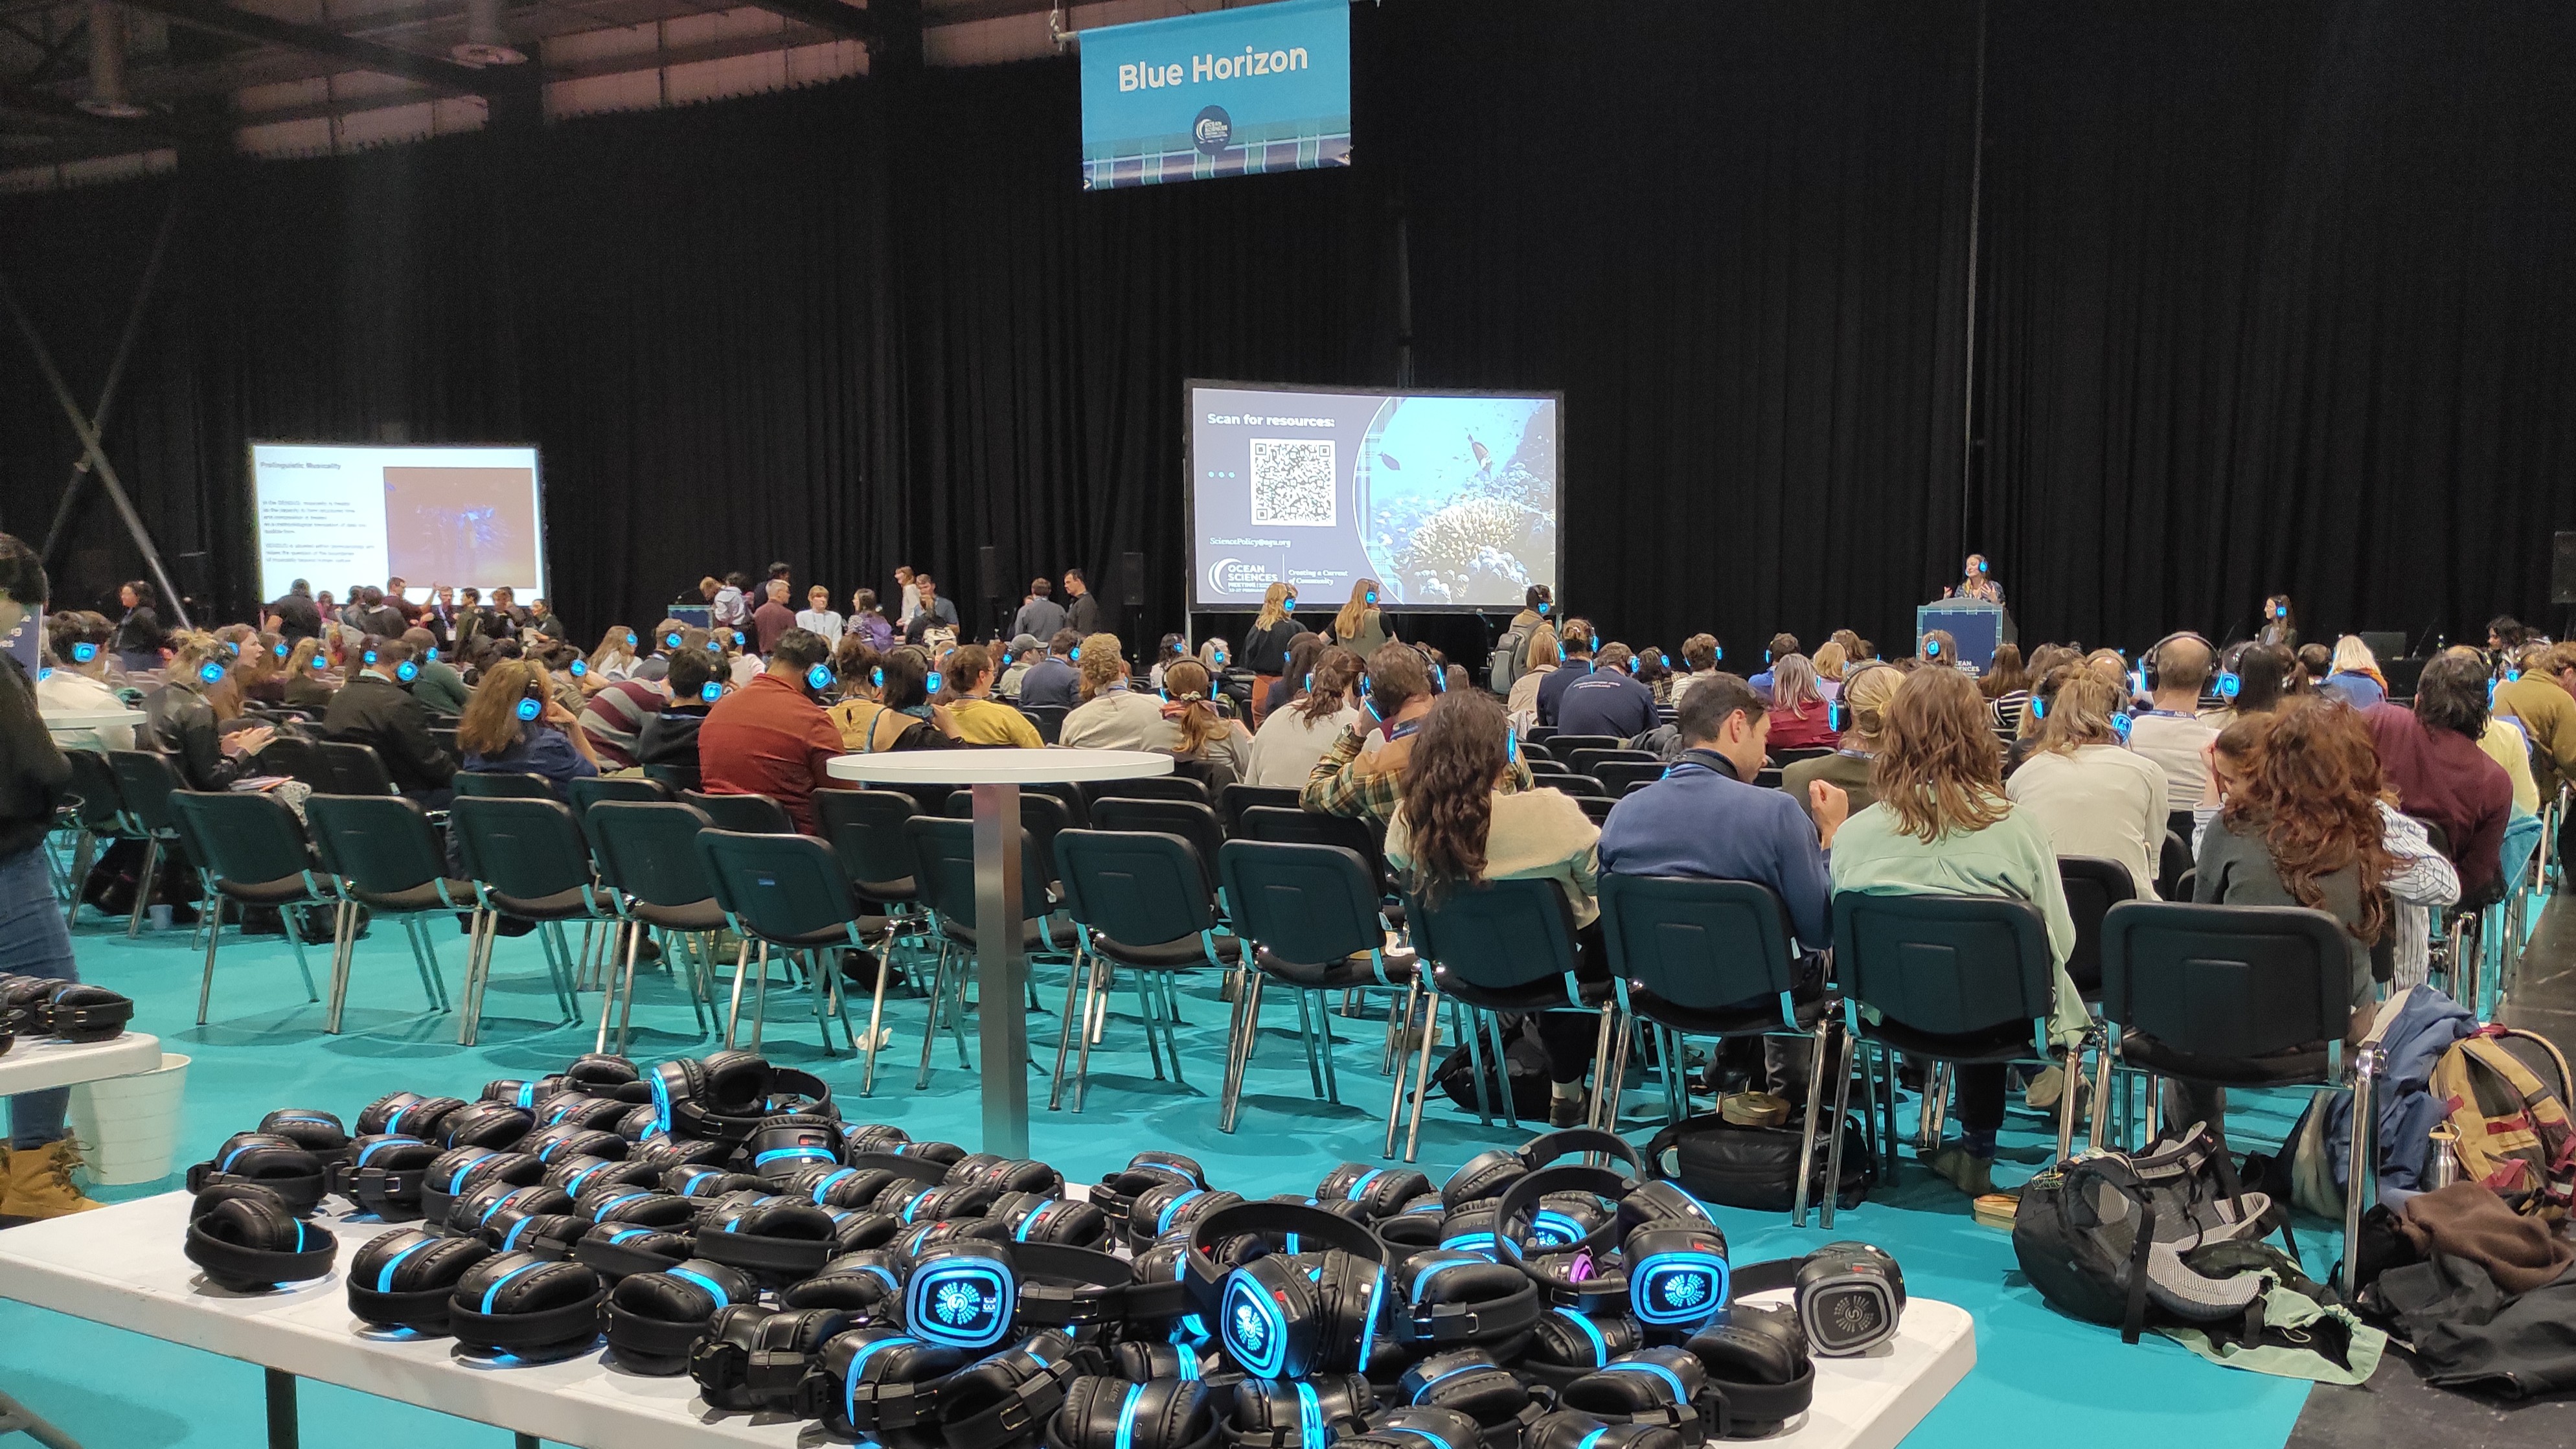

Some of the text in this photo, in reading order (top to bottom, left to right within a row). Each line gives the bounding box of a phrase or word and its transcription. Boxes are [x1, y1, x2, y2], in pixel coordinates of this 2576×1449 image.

[1119, 45, 1308, 92] Blue Horizon
[1207, 413, 1335, 428] Scan for resources:
[1227, 564, 1265, 573] OCEAN
[1227, 573, 1278, 582] SCIENCES
